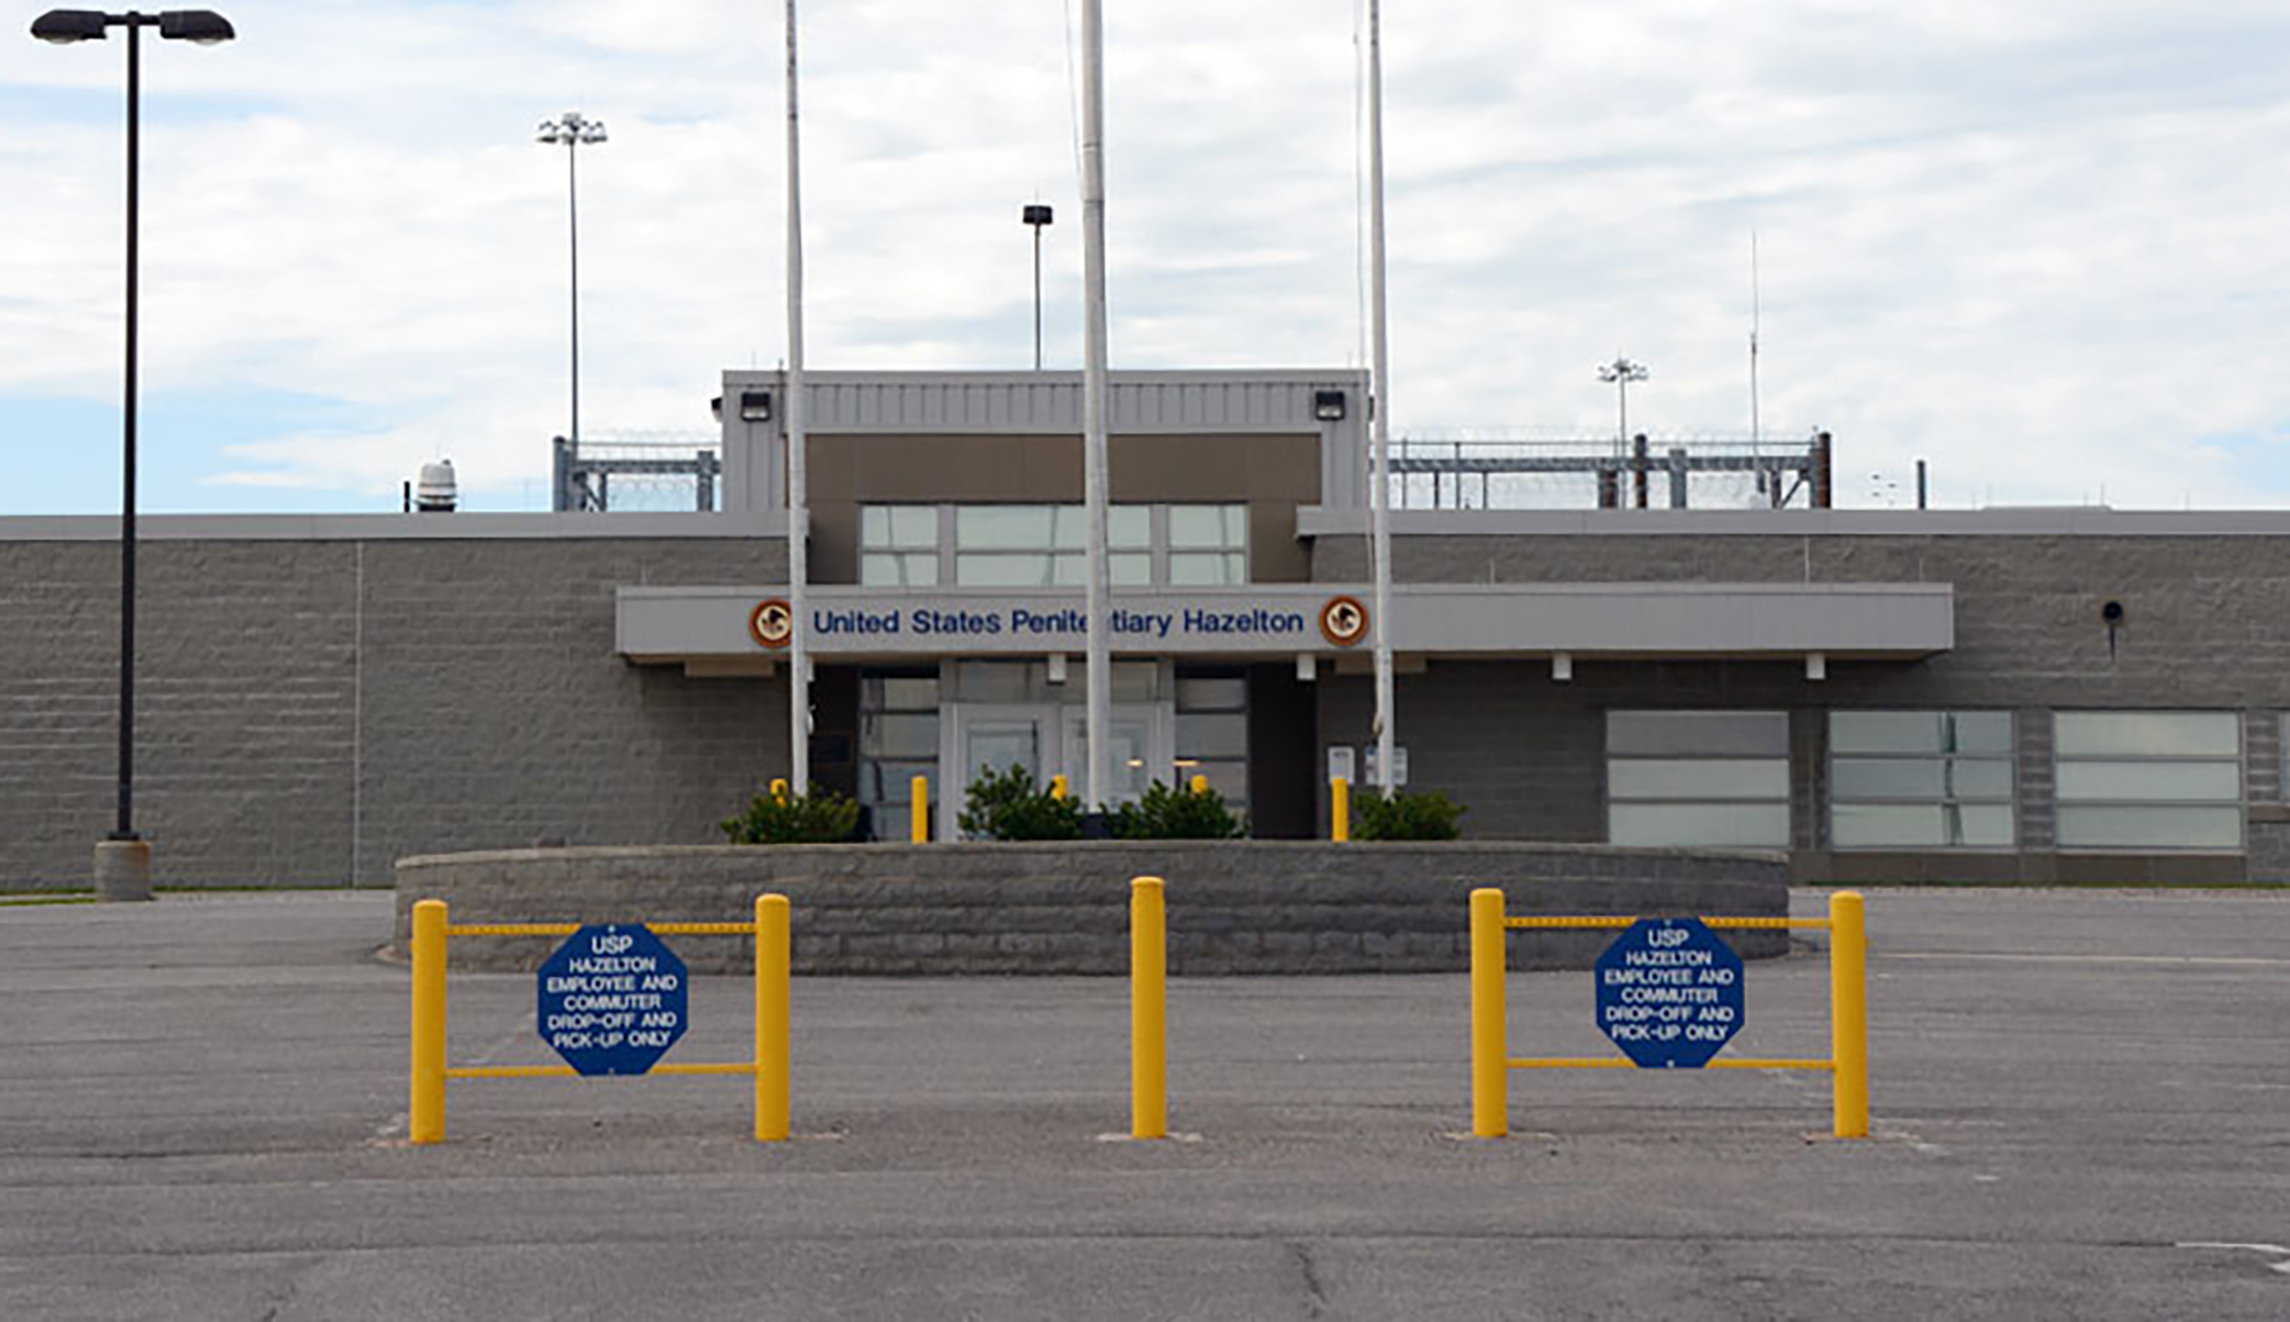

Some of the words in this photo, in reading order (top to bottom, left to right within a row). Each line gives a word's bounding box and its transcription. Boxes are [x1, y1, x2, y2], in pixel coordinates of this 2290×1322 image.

[814, 609, 899, 634] United
[911, 609, 1002, 634] States
[1183, 608, 1304, 633] Hazelton
[591, 935, 633, 954] USP
[1648, 928, 1689, 947] USP
[569, 957, 656, 973] HAZELTON
[1626, 951, 1712, 966] HAZELTON
[547, 975, 636, 993] EMPLOYEE
[641, 974, 678, 991] AND
[1604, 969, 1693, 985] EMPLOYEE
[1698, 968, 1734, 985] AND
[563, 994, 662, 1011] COMMUTER
[1621, 987, 1718, 1003] COMMUTER
[547, 1012, 635, 1030] DROP-OFF
[641, 1011, 677, 1027] AND
[1606, 1006, 1693, 1022] DROP-OFF
[1698, 1006, 1734, 1022] AND
[553, 1032, 623, 1048] PICK-UP
[628, 1031, 671, 1047] ONLY
[1612, 1024, 1681, 1040] PICK-UP
[1685, 1024, 1728, 1041] ONLY
